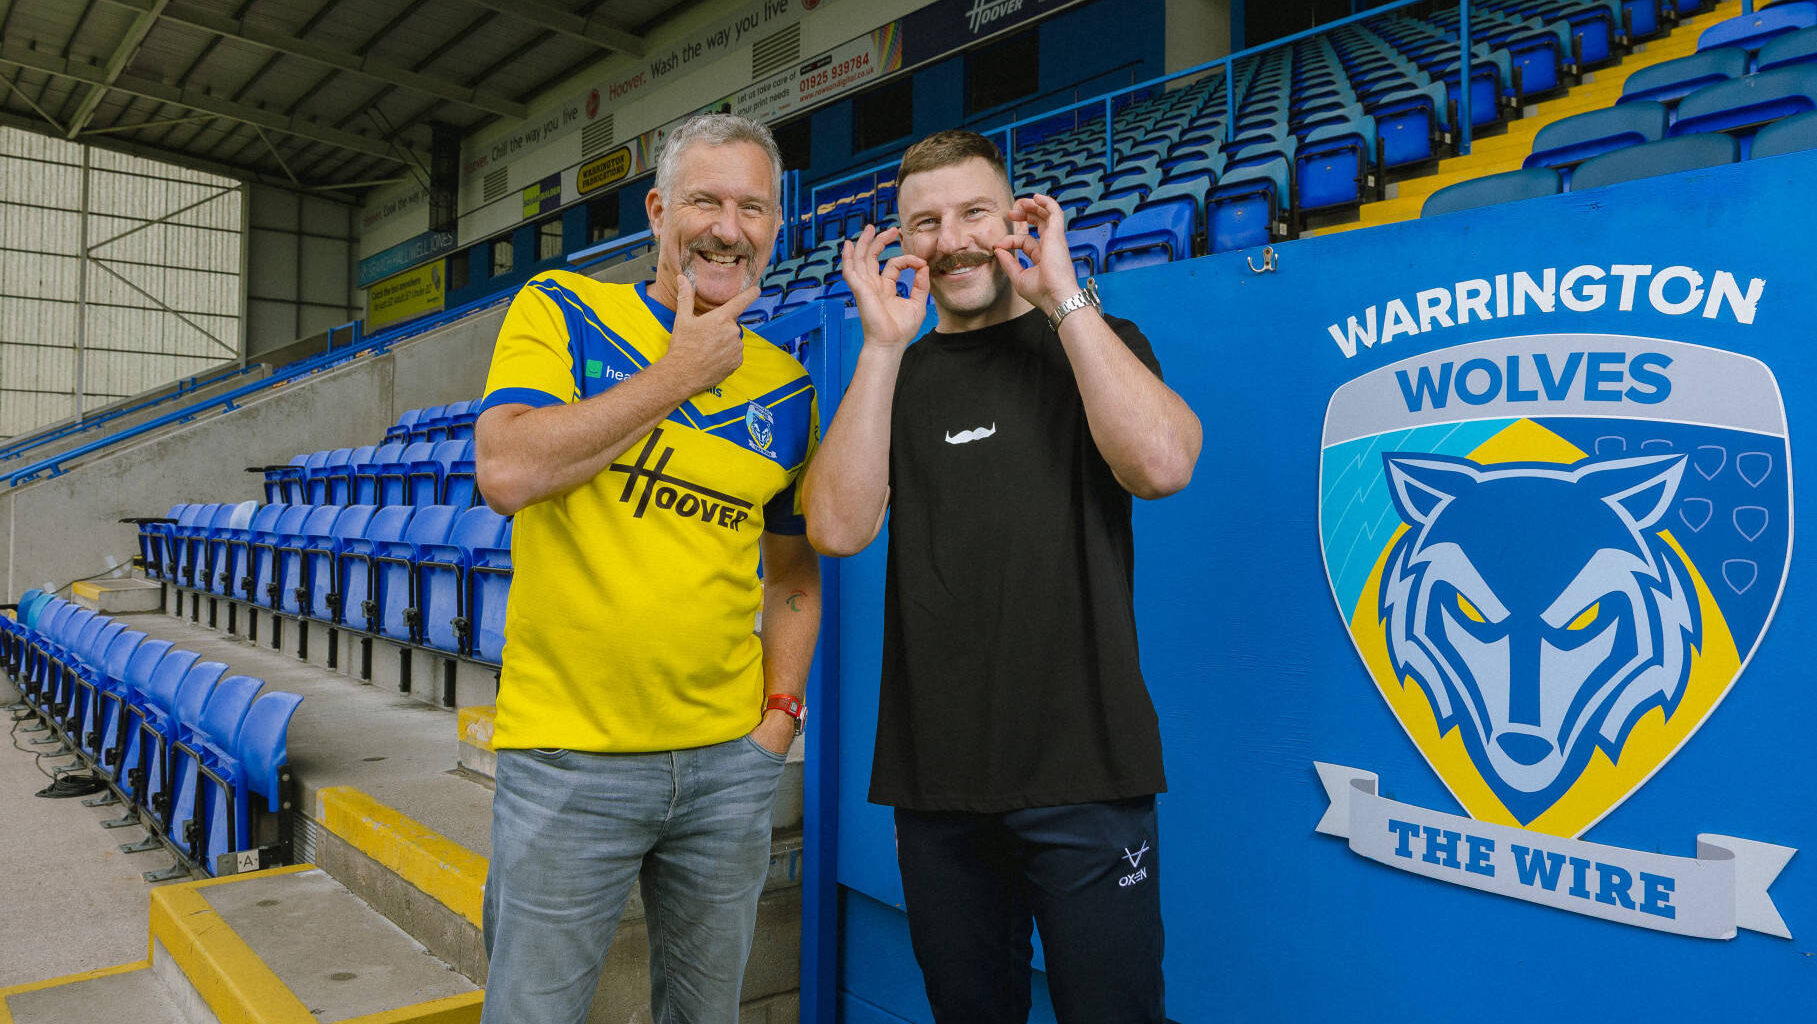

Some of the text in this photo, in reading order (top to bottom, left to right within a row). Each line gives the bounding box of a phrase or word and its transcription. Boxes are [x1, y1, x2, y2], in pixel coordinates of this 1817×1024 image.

[609, 0, 788, 101] Hoover. Wash the way you live
[800, 72, 829, 93] 01925
[831, 51, 869, 79] 939784
[737, 89, 748, 105] Let
[757, 81, 772, 98] take
[772, 75, 789, 89] care
[1328, 263, 1767, 359] WARRINGTON
[1395, 351, 1674, 413] WOLVES
[609, 427, 754, 532] HOOVER
[243, 855, 254, 868] A
[1118, 866, 1147, 887] OXEN
[1388, 818, 1676, 920] THE WIRE
